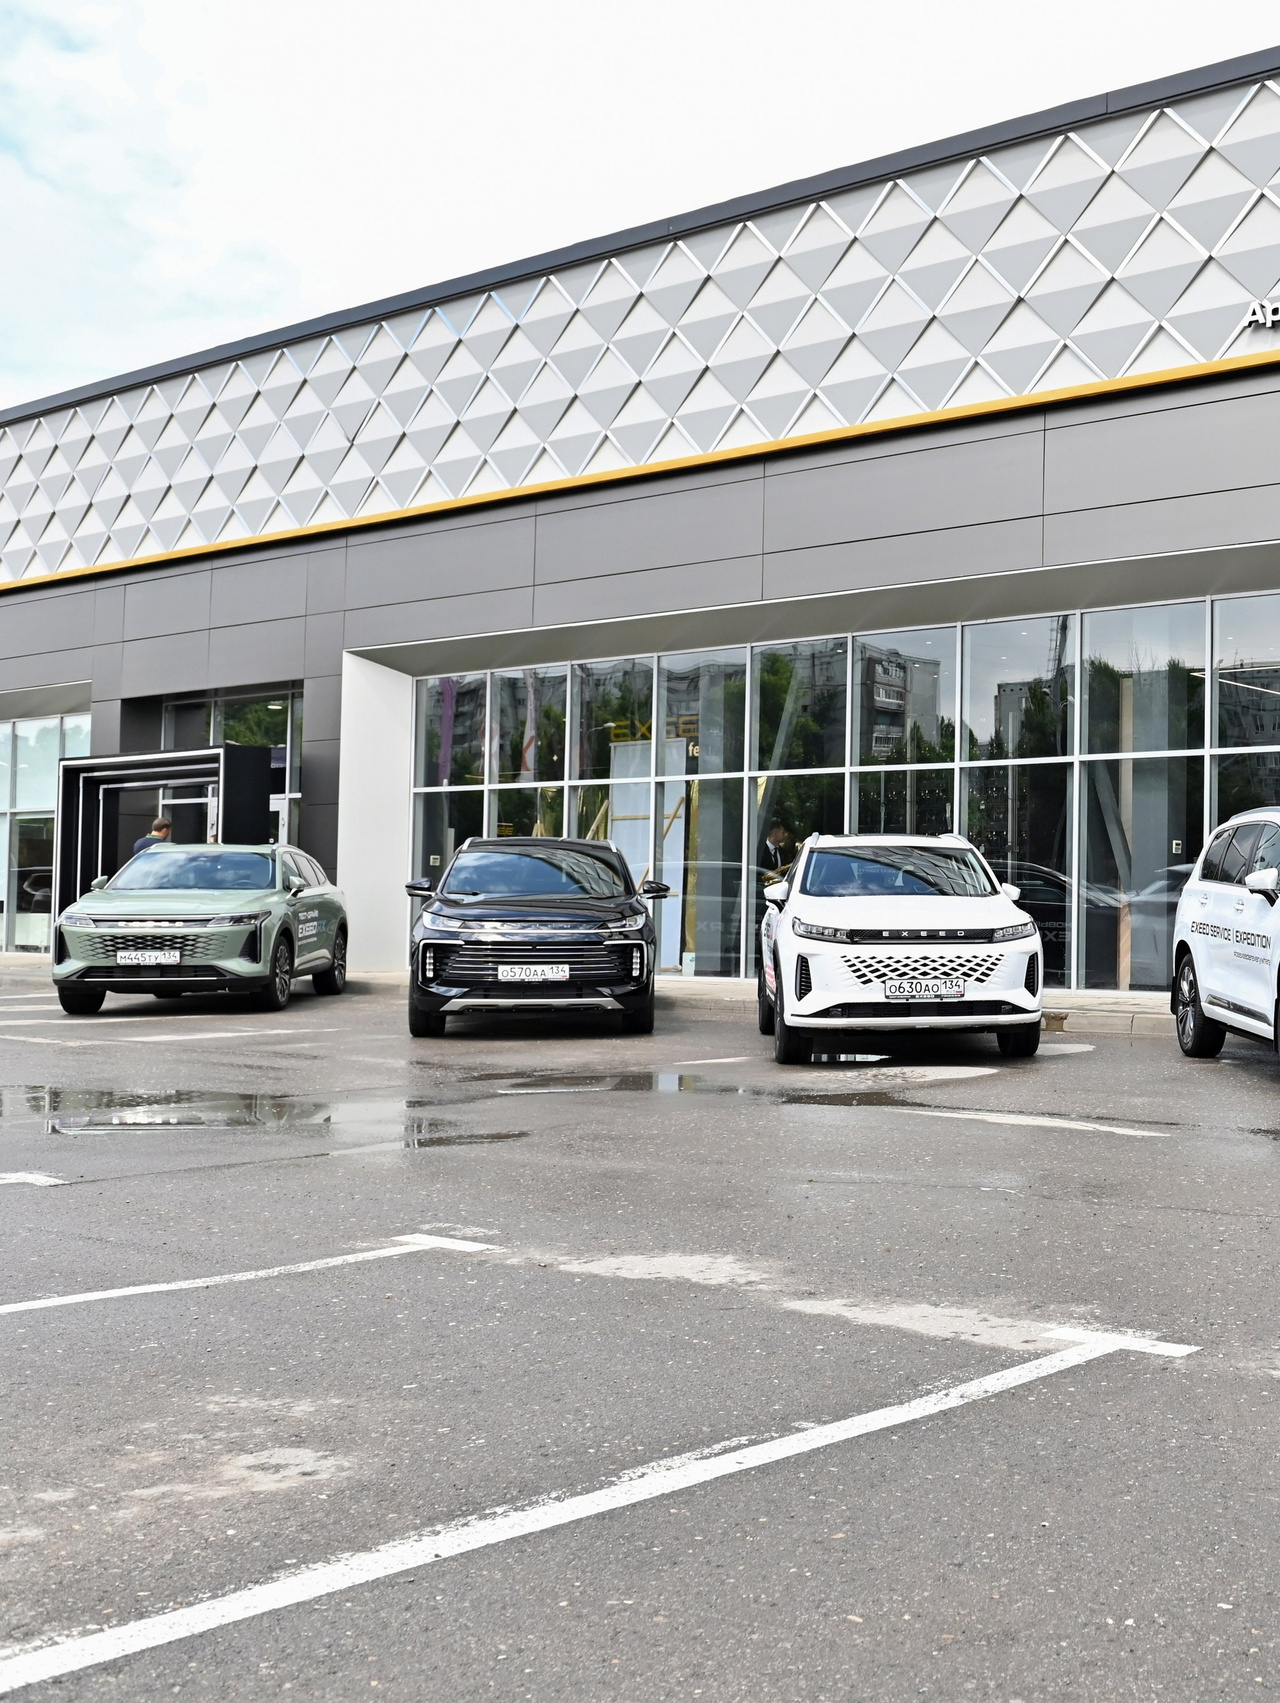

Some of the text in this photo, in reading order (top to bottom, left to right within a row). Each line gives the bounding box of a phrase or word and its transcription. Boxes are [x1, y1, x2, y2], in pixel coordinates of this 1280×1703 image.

[1190, 921, 1272, 949] EXEED SERVICE EXPEDITION
[549, 966, 566, 975] 134
[889, 980, 961, 994] О630АО 134
